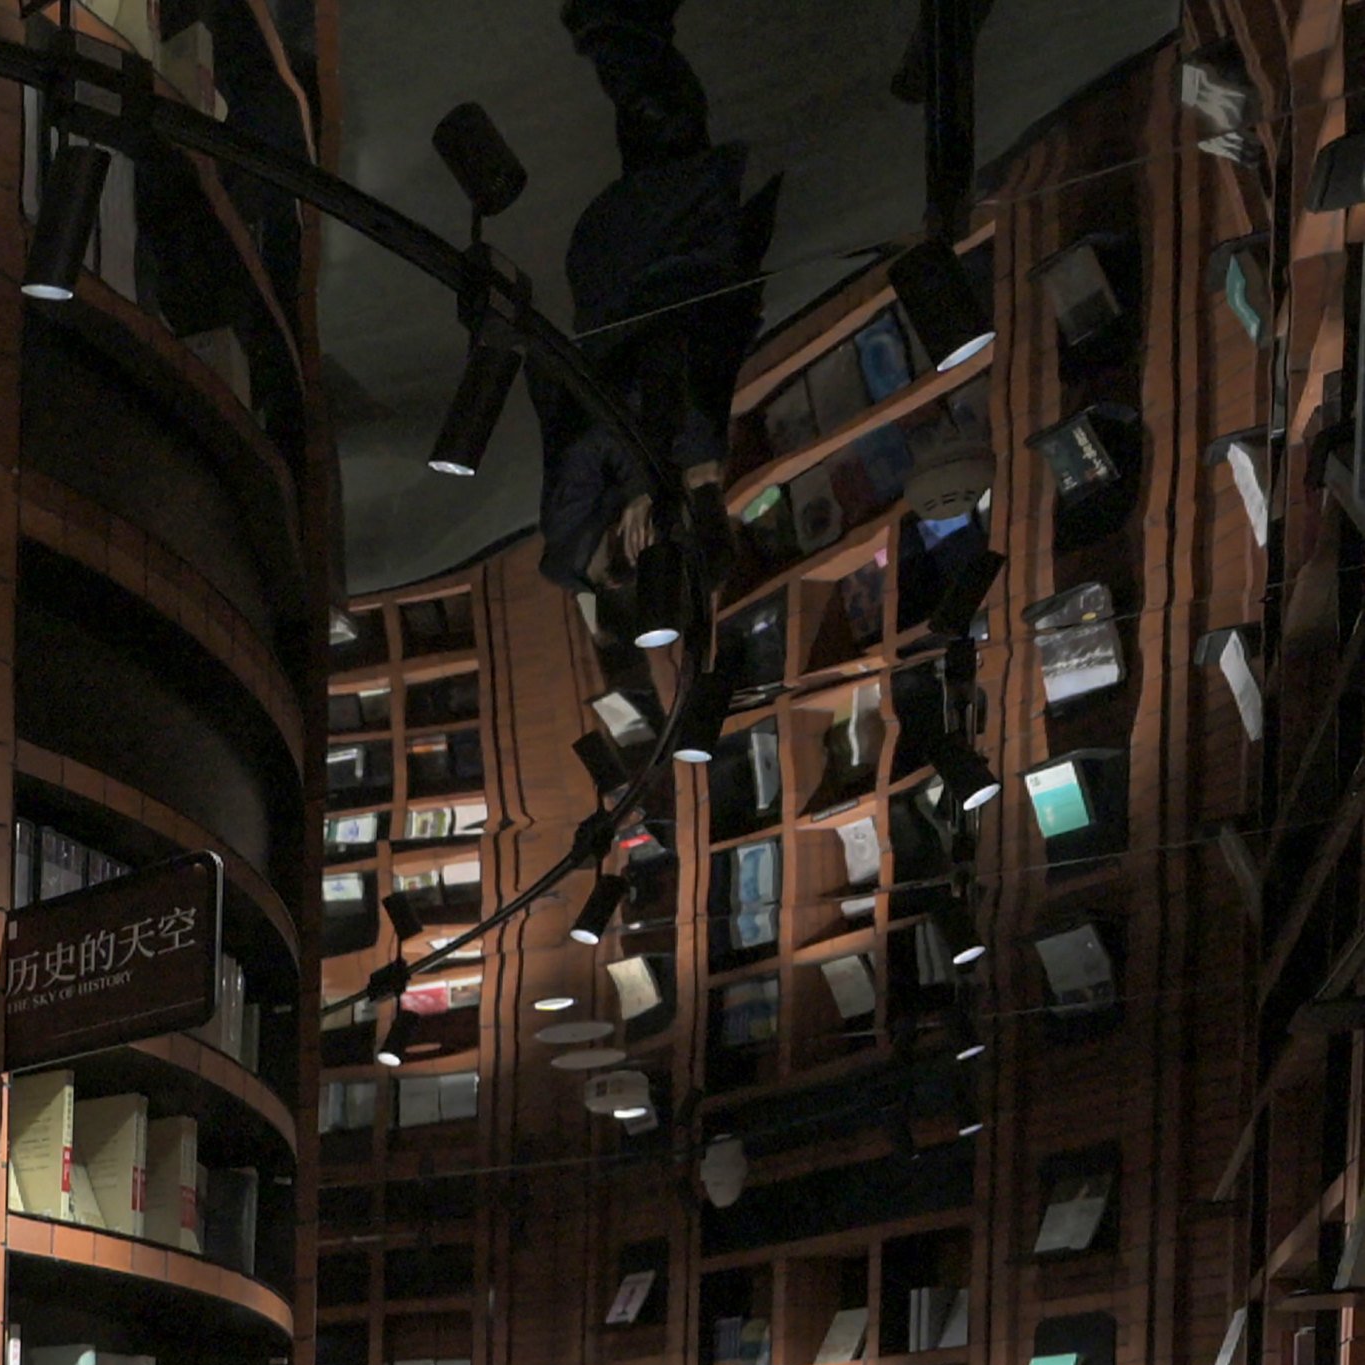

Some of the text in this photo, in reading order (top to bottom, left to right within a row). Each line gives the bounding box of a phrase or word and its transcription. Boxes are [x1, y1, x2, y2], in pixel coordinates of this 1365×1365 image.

[6, 907, 197, 997] 历史的天空
[7, 970, 133, 1015] THE SKY OF HISTORY
